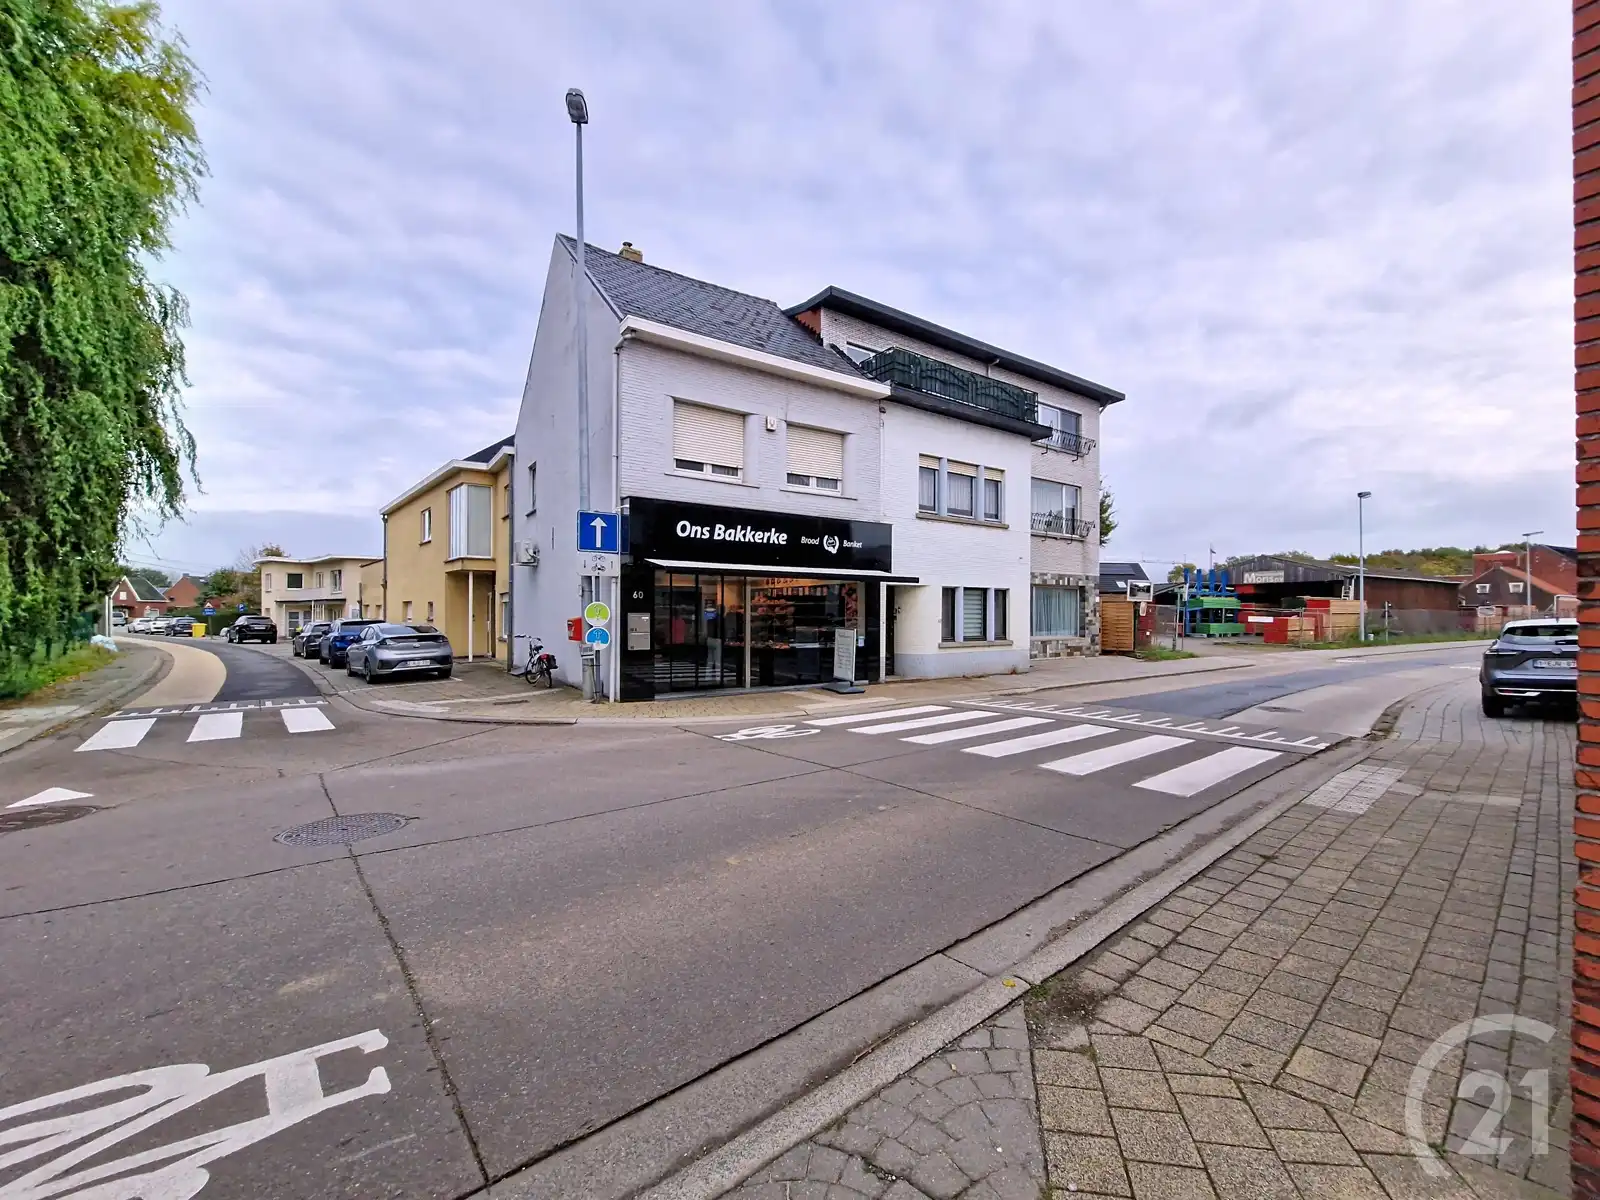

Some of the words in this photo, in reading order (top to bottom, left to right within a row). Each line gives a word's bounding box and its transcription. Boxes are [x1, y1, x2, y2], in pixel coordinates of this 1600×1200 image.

[676, 520, 711, 540] Ons
[713, 523, 788, 545] Bakkerke
[800, 536, 820, 545] Brood
[842, 539, 863, 549] Banket
[632, 590, 644, 599] 60
